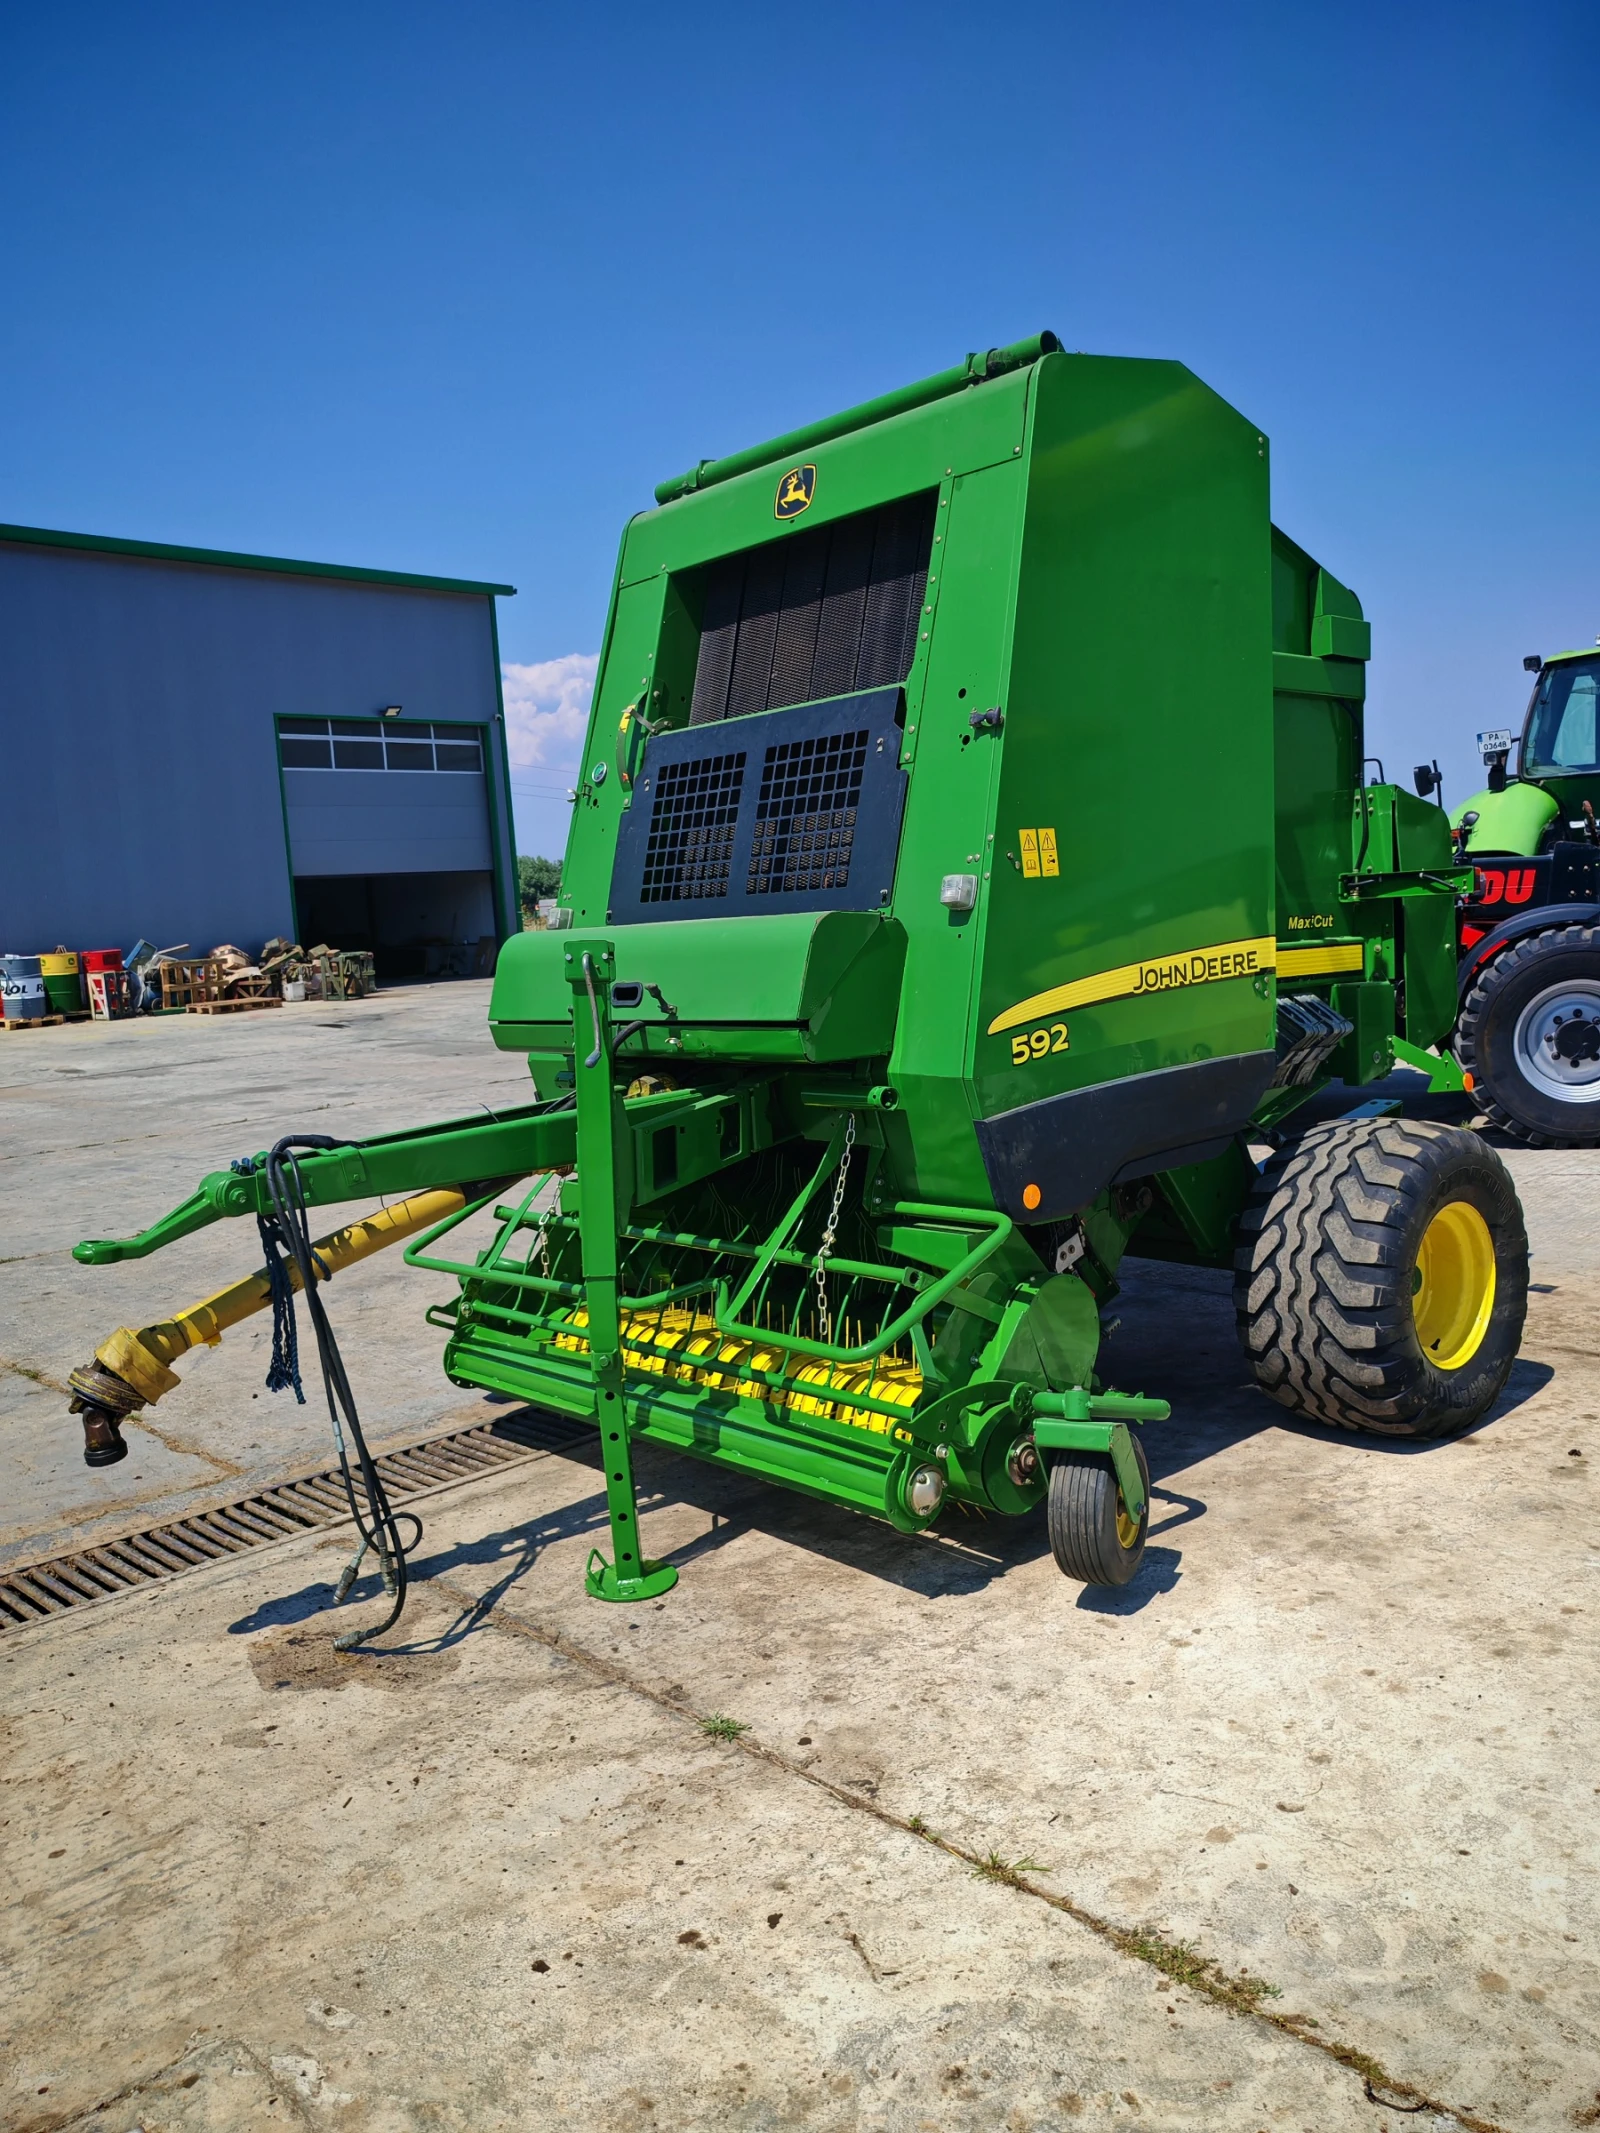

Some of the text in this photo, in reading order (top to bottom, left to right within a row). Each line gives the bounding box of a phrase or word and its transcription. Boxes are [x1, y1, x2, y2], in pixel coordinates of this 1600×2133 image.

[1488, 733, 1500, 741] PA
[1133, 950, 1259, 991] JOHN DEERE
[1011, 1021, 1070, 1067] 592
